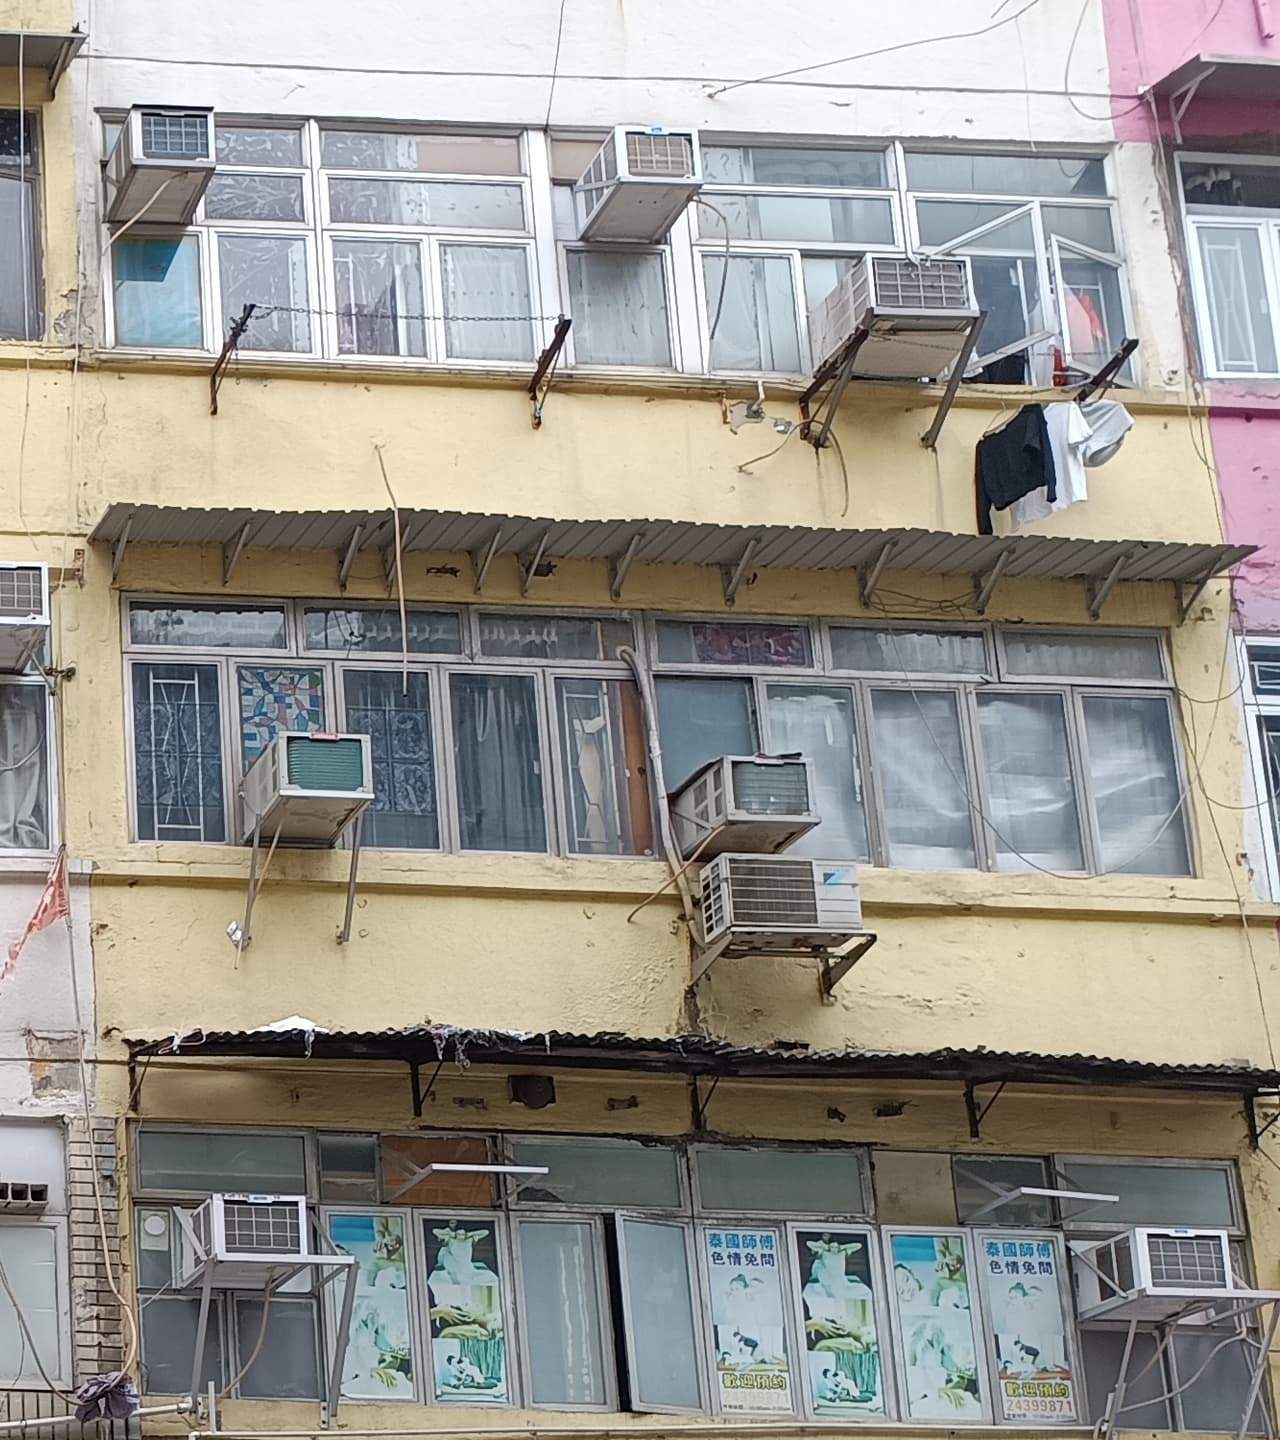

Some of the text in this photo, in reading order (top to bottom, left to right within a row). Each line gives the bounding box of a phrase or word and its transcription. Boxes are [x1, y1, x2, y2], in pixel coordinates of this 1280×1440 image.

[708, 1232, 775, 1251] 泰國師傅
[985, 1241, 1052, 1259] 泰國師傅
[711, 1251, 776, 1268] 色情免問
[989, 1260, 1054, 1276] 色情免問
[1007, 1399, 1073, 1413] 24399871
